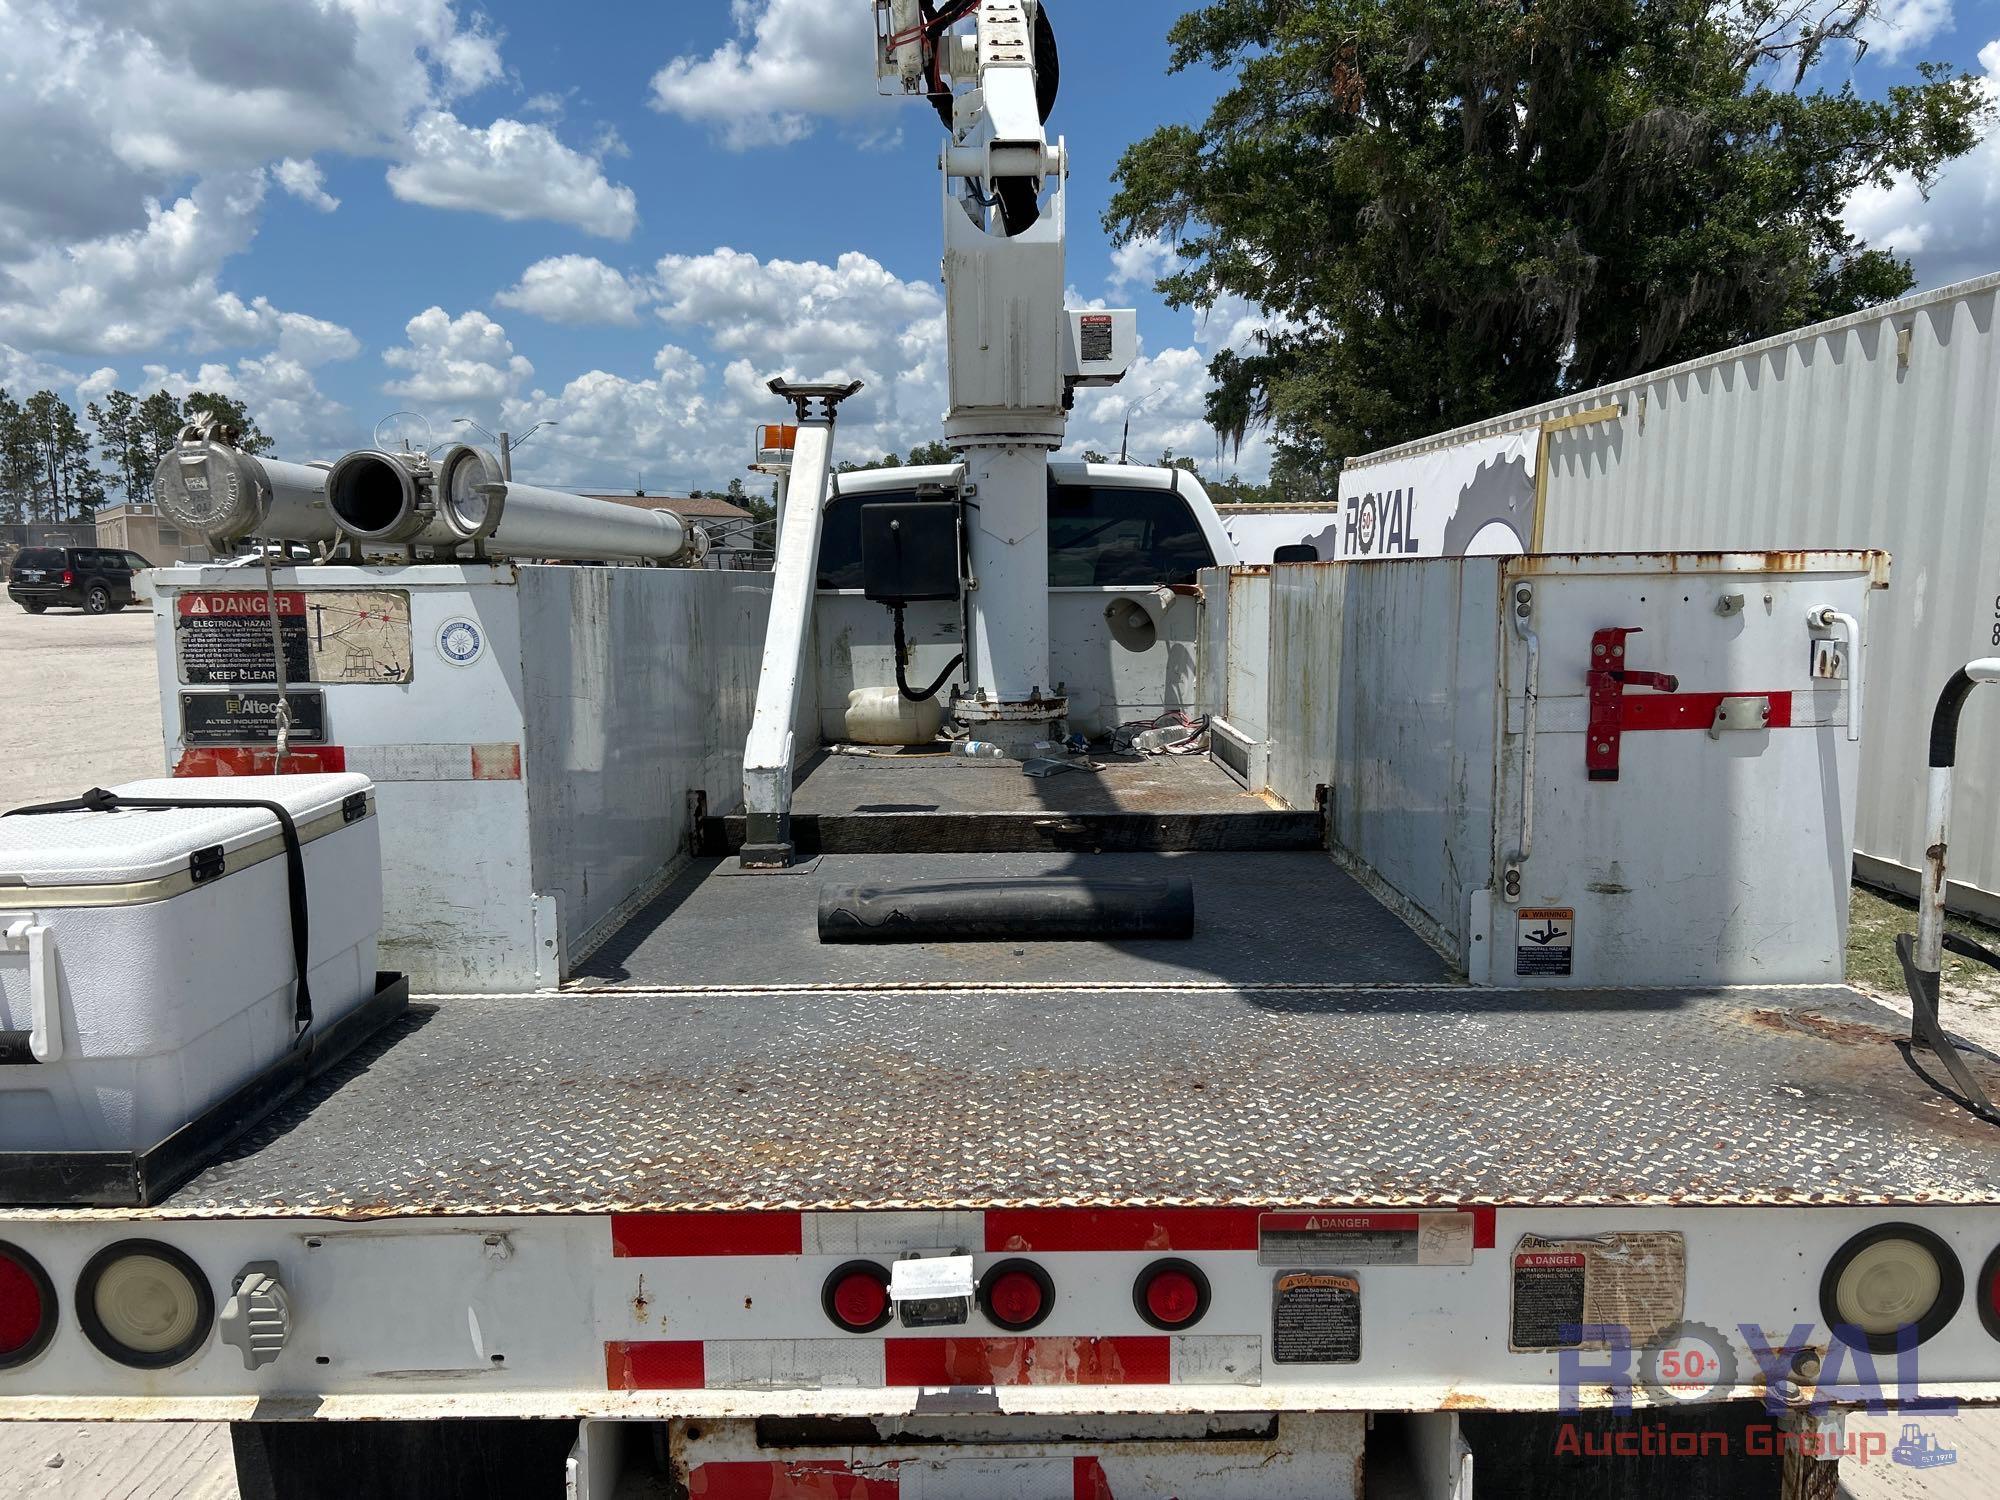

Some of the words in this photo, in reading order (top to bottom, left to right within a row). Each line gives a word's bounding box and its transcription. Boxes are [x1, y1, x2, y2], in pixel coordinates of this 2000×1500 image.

[1344, 487, 1419, 555] ROYAL
[193, 620, 242, 628] ELECTRICAL
[209, 671, 238, 680] KEEP
[240, 671, 276, 680] CLEAR
[242, 700, 278, 714] Altec
[1322, 1219, 1370, 1228] DANGER
[1535, 1256, 1577, 1265] DANGER
[1297, 1277, 1350, 1288] WARNING
